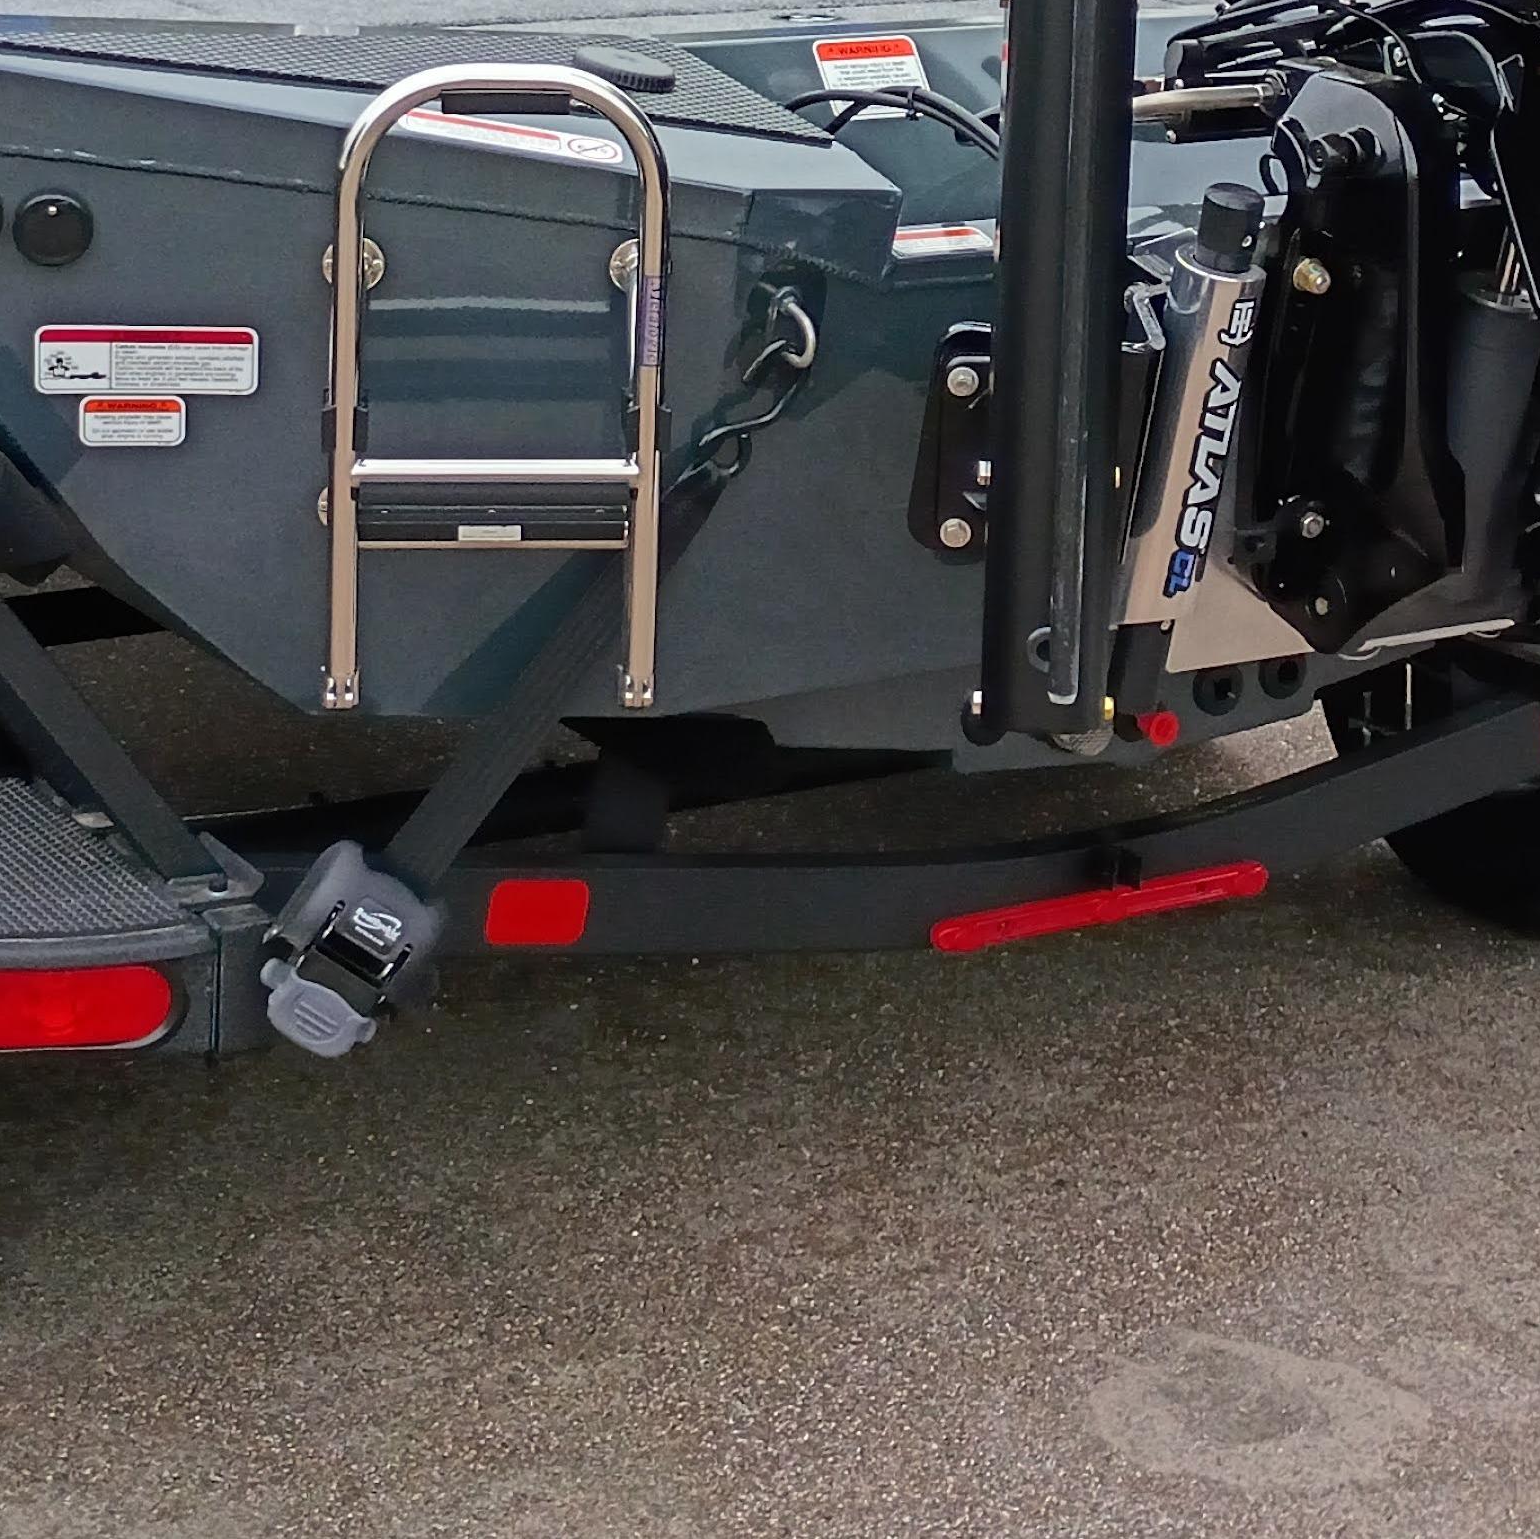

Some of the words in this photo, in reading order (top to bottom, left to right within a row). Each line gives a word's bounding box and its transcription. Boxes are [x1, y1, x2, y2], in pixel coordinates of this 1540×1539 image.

[838, 43, 892, 56] WARNING
[106, 402, 158, 410] WARNING
[1179, 359, 1242, 554] ATLAS
